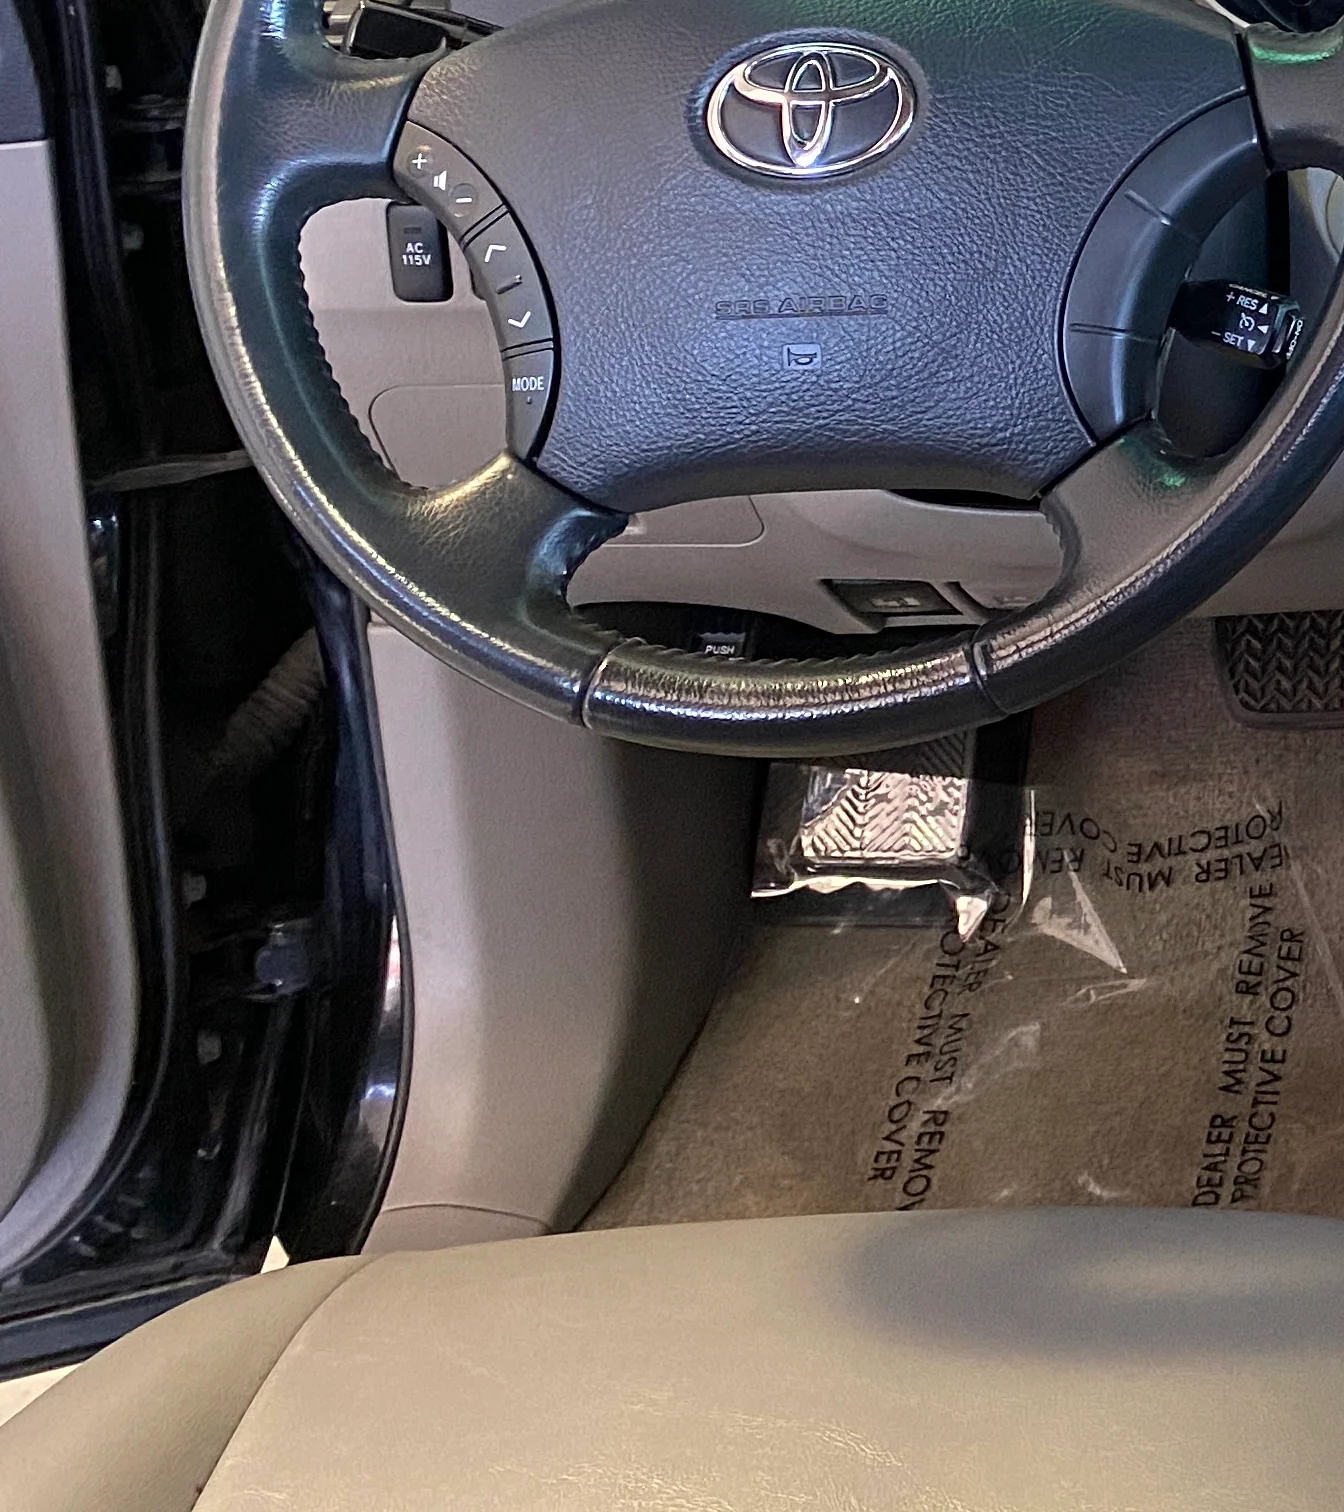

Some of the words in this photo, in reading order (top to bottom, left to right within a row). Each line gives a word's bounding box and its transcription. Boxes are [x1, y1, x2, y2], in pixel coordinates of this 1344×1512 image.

[402, 254, 432, 266] 115V
[406, 242, 424, 254] AC
[715, 299, 770, 317] SRS
[778, 293, 888, 314] AIRBAG
[1236, 295, 1259, 310] RES
[1223, 331, 1244, 347] SET
[512, 378, 544, 392] MODE
[704, 643, 735, 656] PUSH
[1035, 810, 1119, 854] COVE
[1103, 859, 1173, 894] MUST
[1234, 880, 1276, 997] REMOVE
[928, 1012, 972, 1085] MUST
[1216, 1015, 1256, 1096] MUST
[1230, 1047, 1288, 1205] PROTECTIVE
[1264, 927, 1306, 1037] COVER
[866, 1075, 922, 1183] COVER
[1191, 1113, 1238, 1208] DEALER
